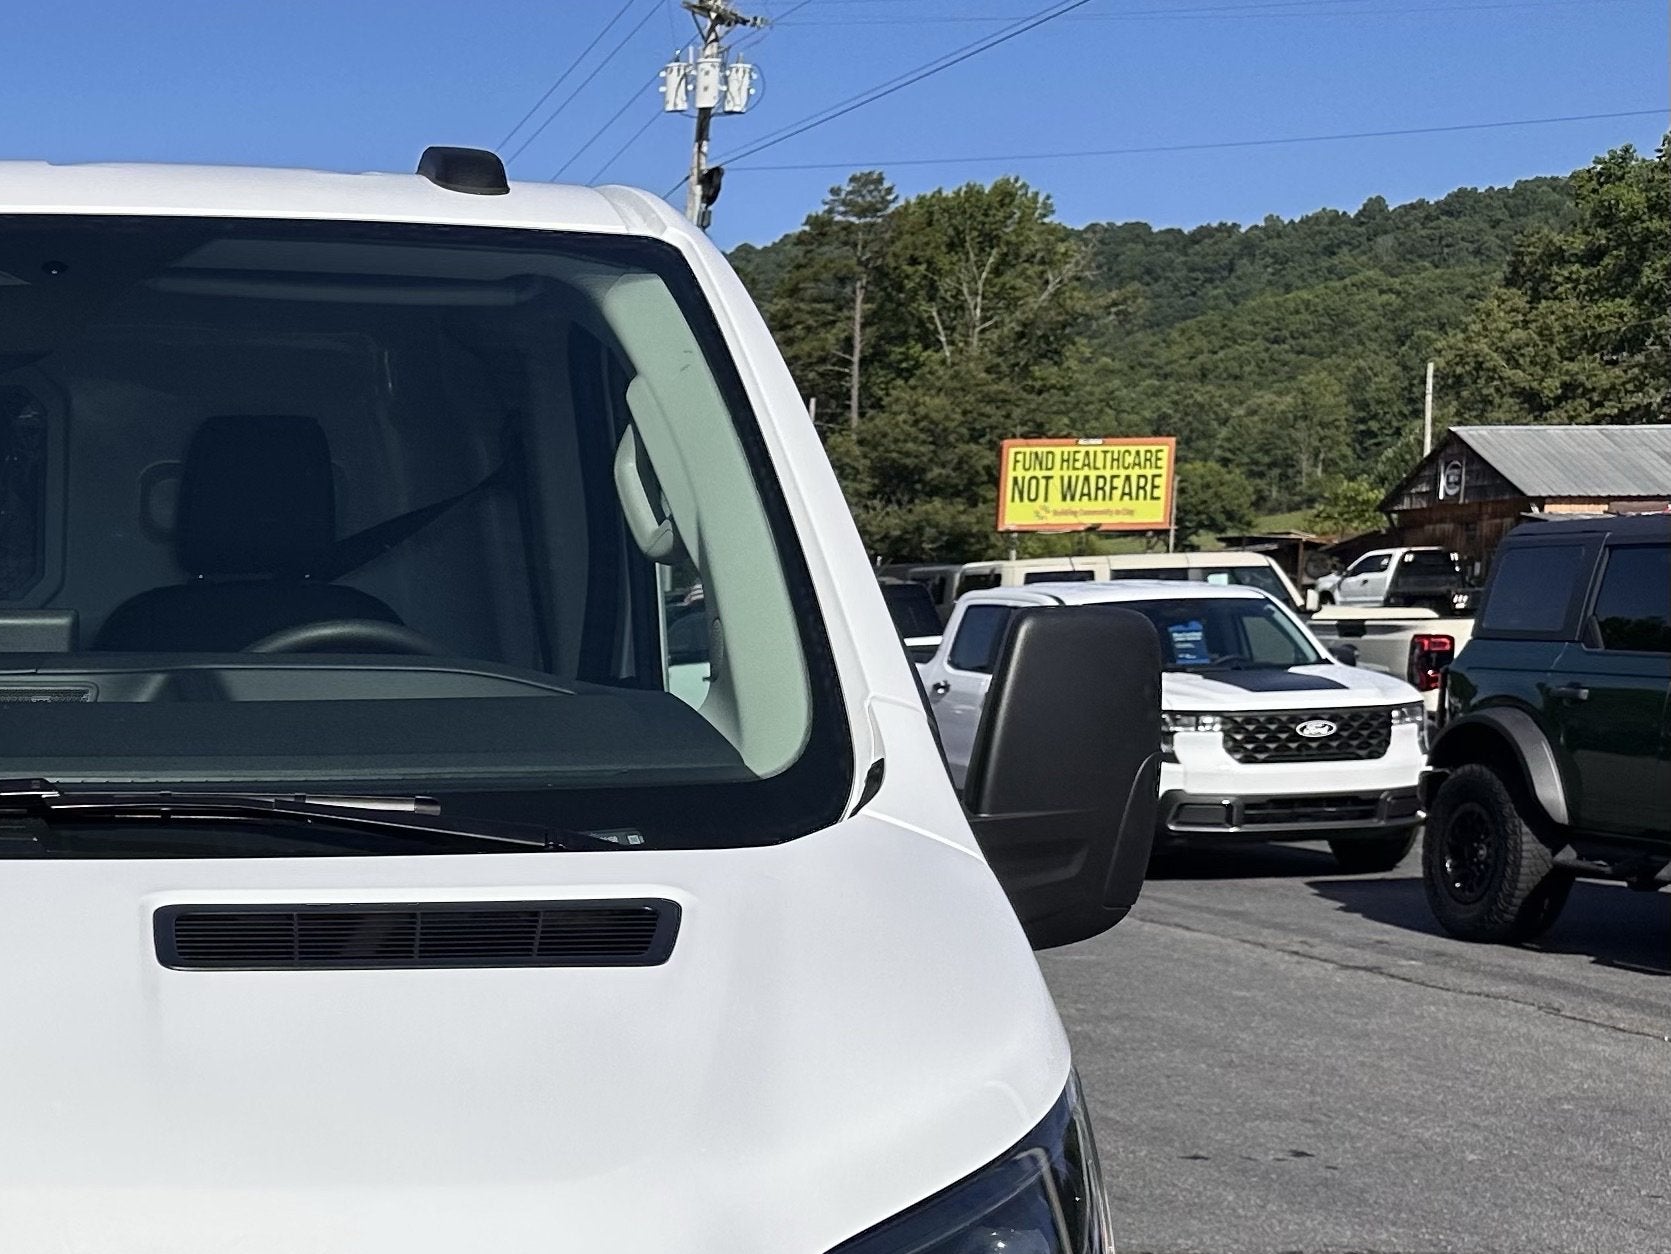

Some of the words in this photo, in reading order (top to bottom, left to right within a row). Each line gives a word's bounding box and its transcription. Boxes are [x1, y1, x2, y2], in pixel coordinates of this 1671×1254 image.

[1013, 451, 1056, 472] FUND
[1060, 449, 1164, 471] HEALTHCARE
[1011, 476, 1053, 503] NOT
[1060, 474, 1162, 502] WARFARE
